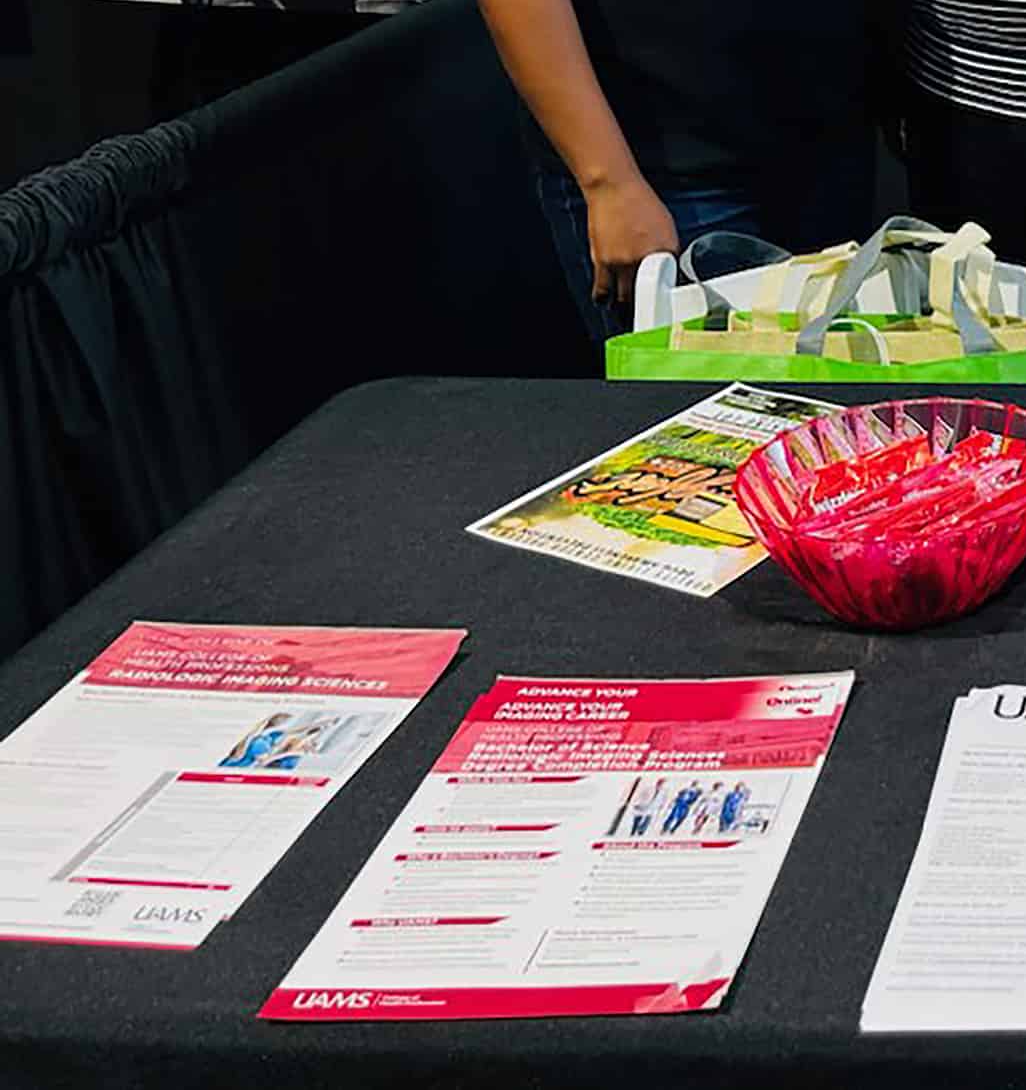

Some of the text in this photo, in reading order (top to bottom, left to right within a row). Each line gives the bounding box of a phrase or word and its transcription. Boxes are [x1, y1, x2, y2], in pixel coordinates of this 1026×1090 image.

[108, 670, 389, 691] RADIOLOGIC IMAGING SCIENCES
[516, 687, 640, 698] ADVANCE YOUR
[498, 701, 625, 712] ADVANCE YOUR
[493, 710, 631, 721] IMAGING CAREER
[473, 741, 651, 752] Bachelor of Science
[467, 750, 727, 762] Radiologic Imaging Sciences
[460, 760, 722, 773] Degree Completion Program
[133, 905, 208, 922] UAMS
[292, 992, 373, 1009] UAMS
